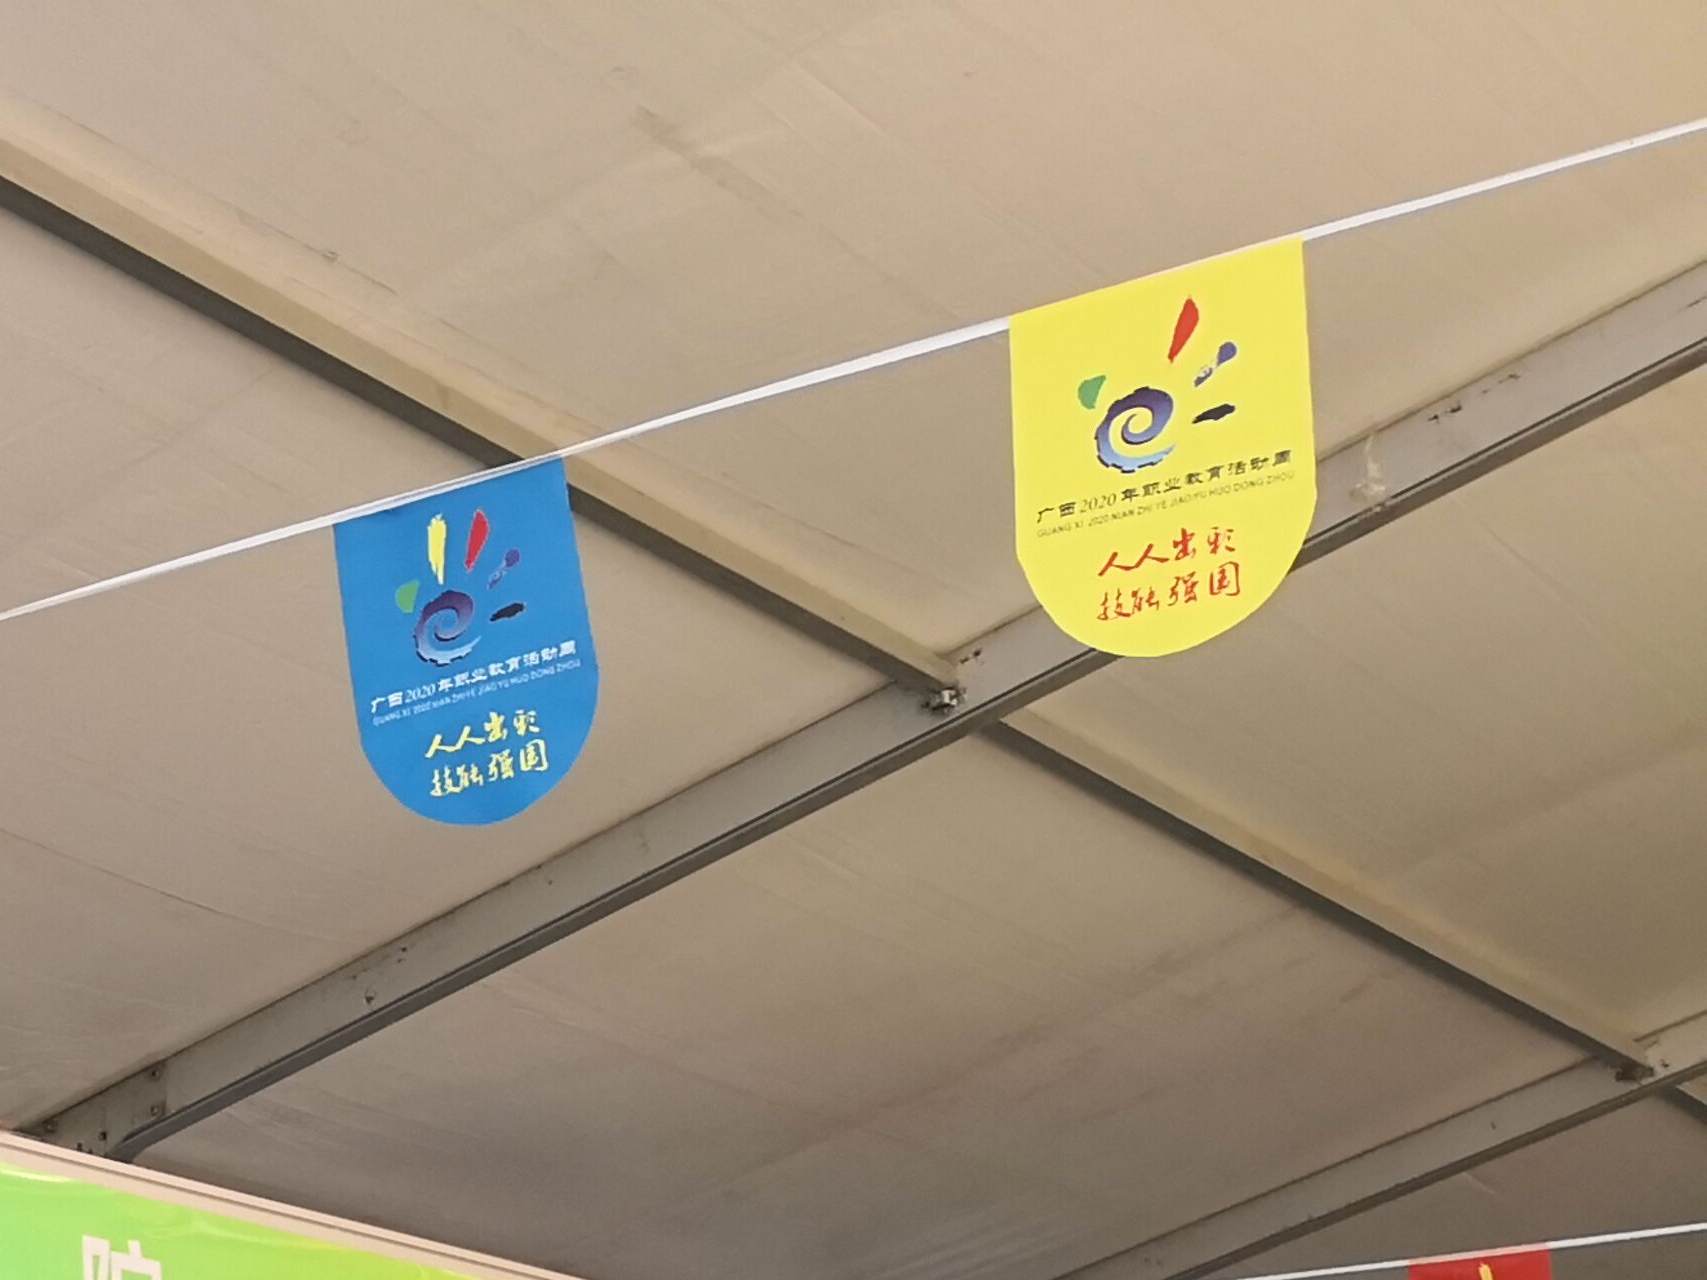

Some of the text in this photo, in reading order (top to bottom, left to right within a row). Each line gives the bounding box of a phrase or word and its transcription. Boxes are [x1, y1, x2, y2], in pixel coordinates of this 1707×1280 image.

[1097, 561, 1241, 621] 技能强国
[430, 739, 549, 797] 技能强国
